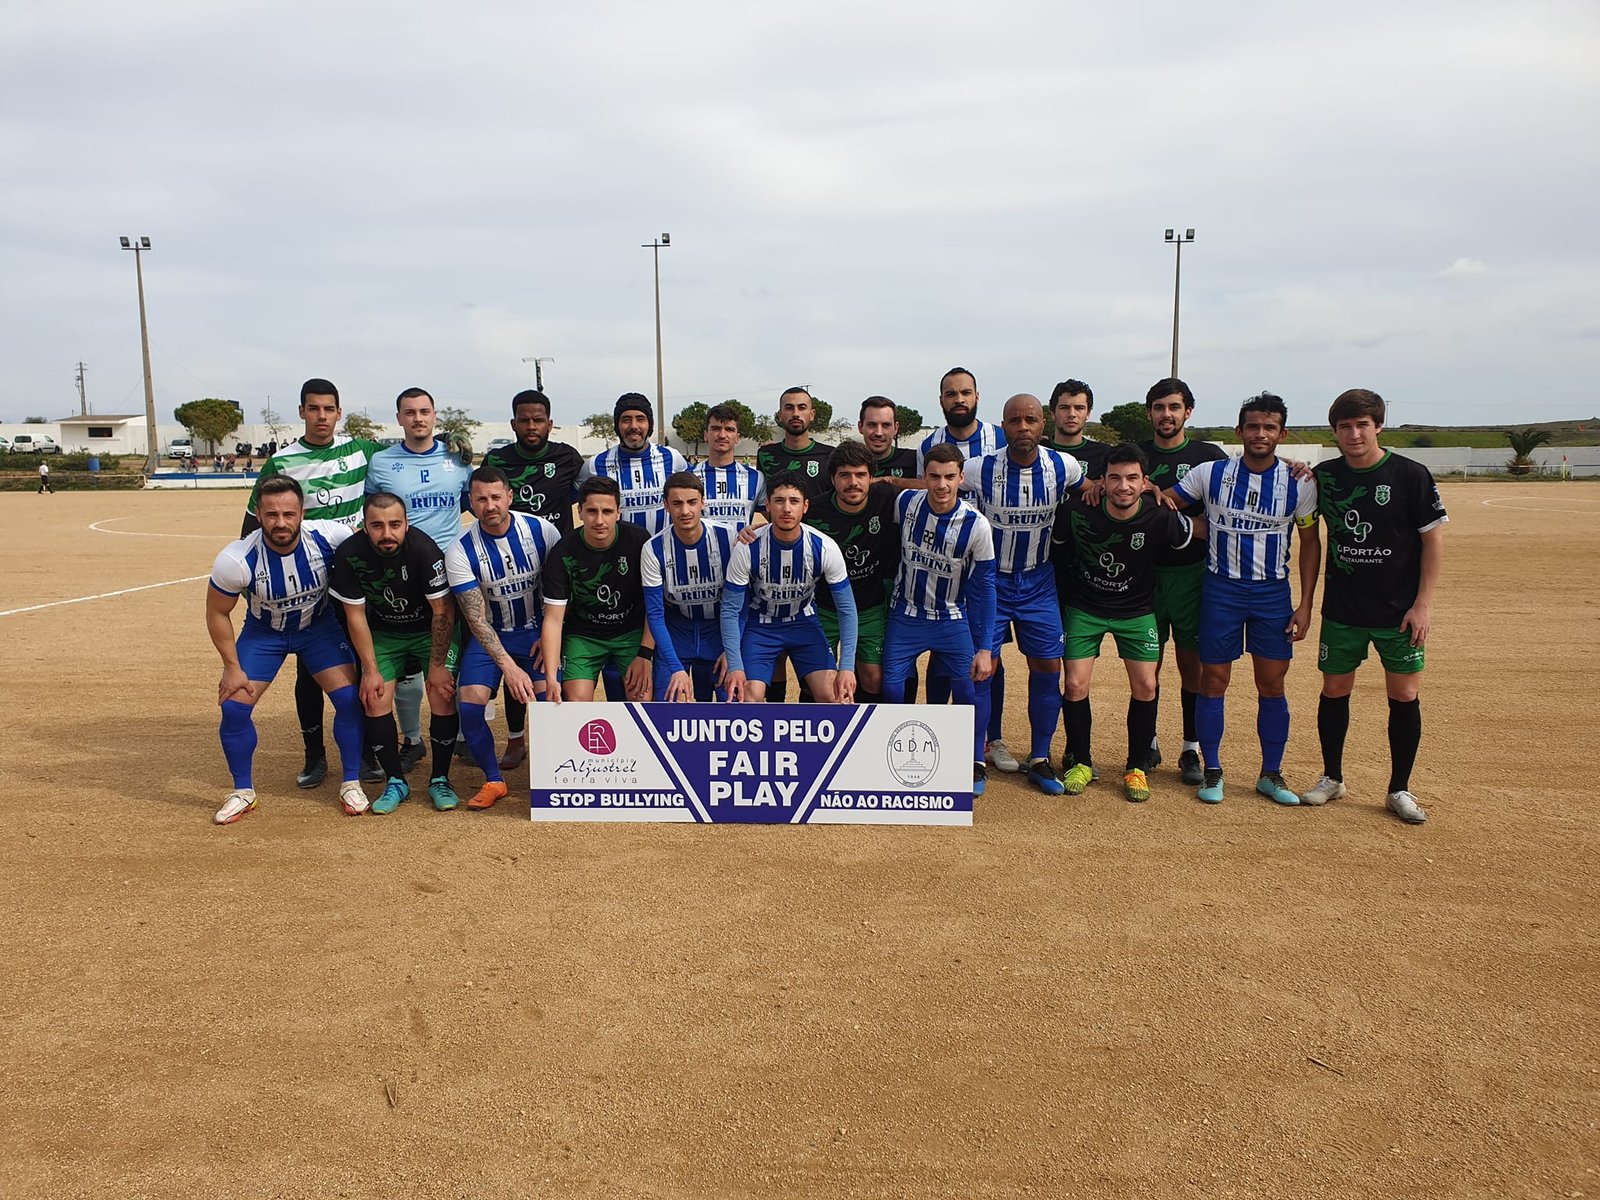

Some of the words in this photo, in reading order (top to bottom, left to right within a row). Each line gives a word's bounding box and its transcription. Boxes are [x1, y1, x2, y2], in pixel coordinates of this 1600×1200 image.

[420, 469, 430, 484] 12
[634, 470, 641, 483] 9
[716, 481, 727, 494] 30
[1022, 485, 1030, 500] 4
[411, 496, 455, 509] RUINA
[1247, 490, 1259, 507] 10
[709, 506, 746, 517] RUINA
[1216, 514, 1226, 526] A
[923, 529, 935, 545] 22
[1343, 546, 1392, 557] PORTÃO
[504, 555, 514, 571] 2
[689, 565, 699, 579] 14
[782, 565, 791, 579] 19
[288, 574, 298, 592] 7
[500, 579, 536, 596] RUIN
[666, 718, 764, 743] JUNTOS
[773, 719, 836, 744] PELO
[554, 758, 637, 777] Aljustrel
[709, 750, 799, 776] FAIR
[554, 775, 596, 784] terra
[605, 776, 638, 784] viva
[549, 793, 596, 807] STOP
[600, 793, 685, 807] BULLYING
[709, 781, 800, 807] PLAY
[820, 791, 854, 808] NÃO
[856, 794, 879, 808] AO
[881, 795, 955, 809] RACISMO
